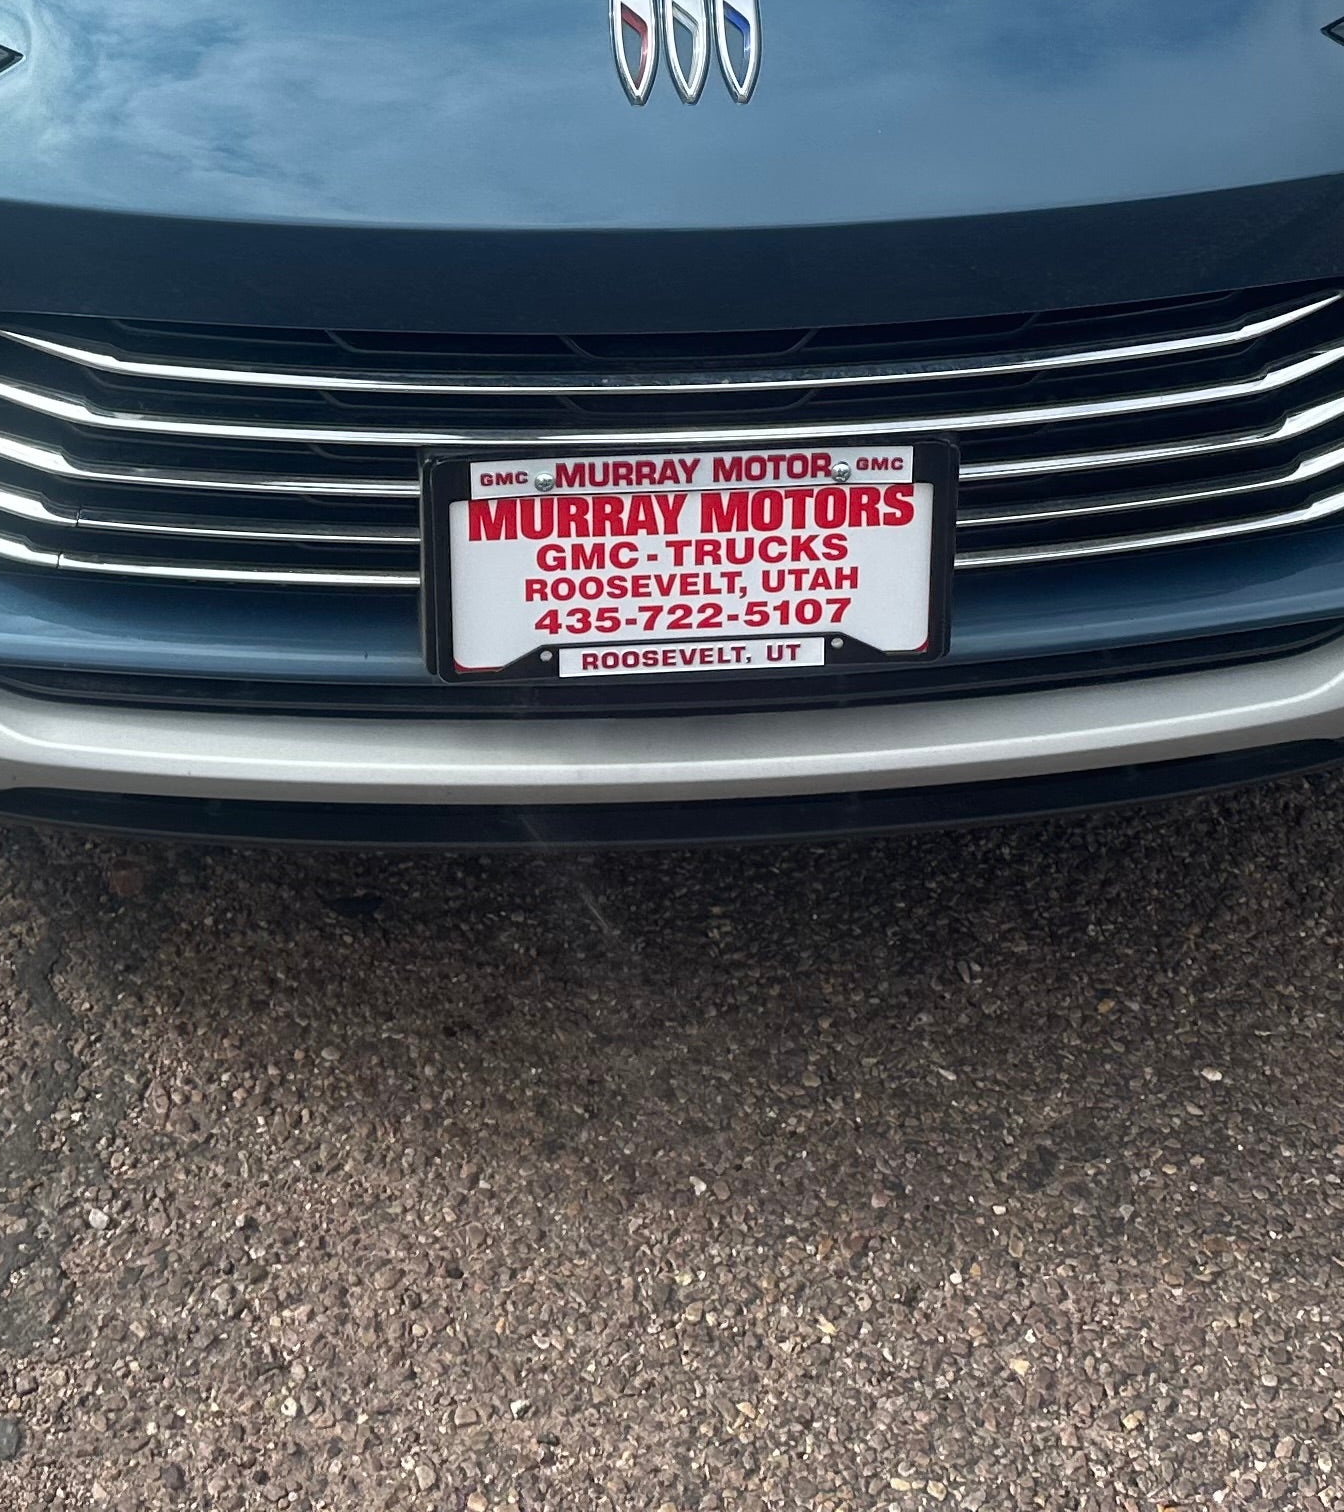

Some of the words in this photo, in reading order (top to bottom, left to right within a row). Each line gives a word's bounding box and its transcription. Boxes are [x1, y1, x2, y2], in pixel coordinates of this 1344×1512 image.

[480, 471, 529, 487] GMC
[555, 459, 700, 488] MURRAY
[712, 453, 832, 482] MOTOR
[856, 457, 904, 471] GMC
[468, 492, 687, 542] MURRAY
[700, 484, 916, 534] MOTORS
[524, 571, 749, 602] ROOSEVELT,
[760, 567, 859, 593] UTAH
[534, 597, 853, 635] 435-722-5107
[581, 646, 753, 671] ROOSEVELT,
[766, 644, 802, 662] UT
